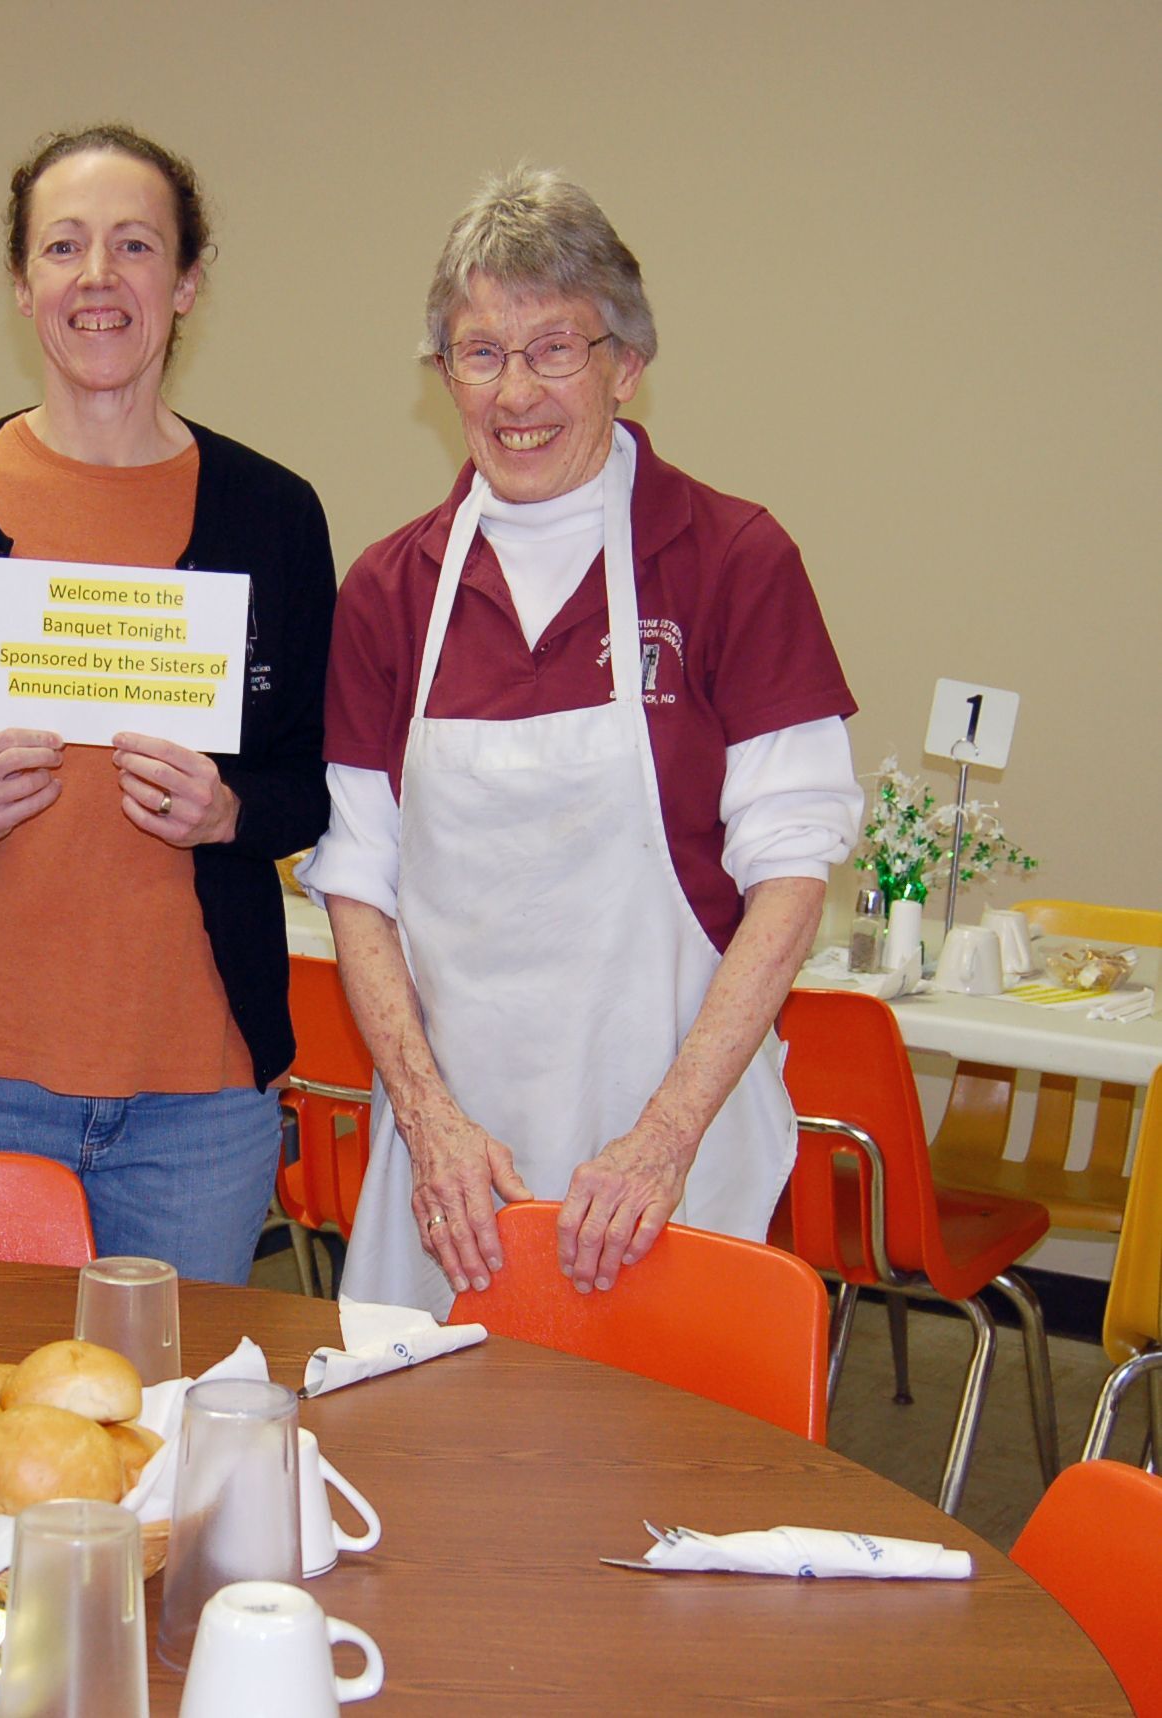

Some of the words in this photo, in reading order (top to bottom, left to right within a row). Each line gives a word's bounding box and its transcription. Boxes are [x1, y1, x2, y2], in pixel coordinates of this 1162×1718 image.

[49, 583, 128, 603] Welcome
[134, 588, 150, 604] to
[156, 589, 184, 606] the
[43, 617, 113, 639] Banquet
[118, 621, 187, 641] Tonight.
[0, 648, 87, 670] Sponsored
[93, 653, 113, 671] by
[117, 655, 145, 671] the
[151, 657, 205, 674] Sisters
[210, 660, 227, 676] of
[9, 678, 119, 699] Annunciation
[125, 688, 216, 706] Monastery
[966, 694, 983, 743] 1
